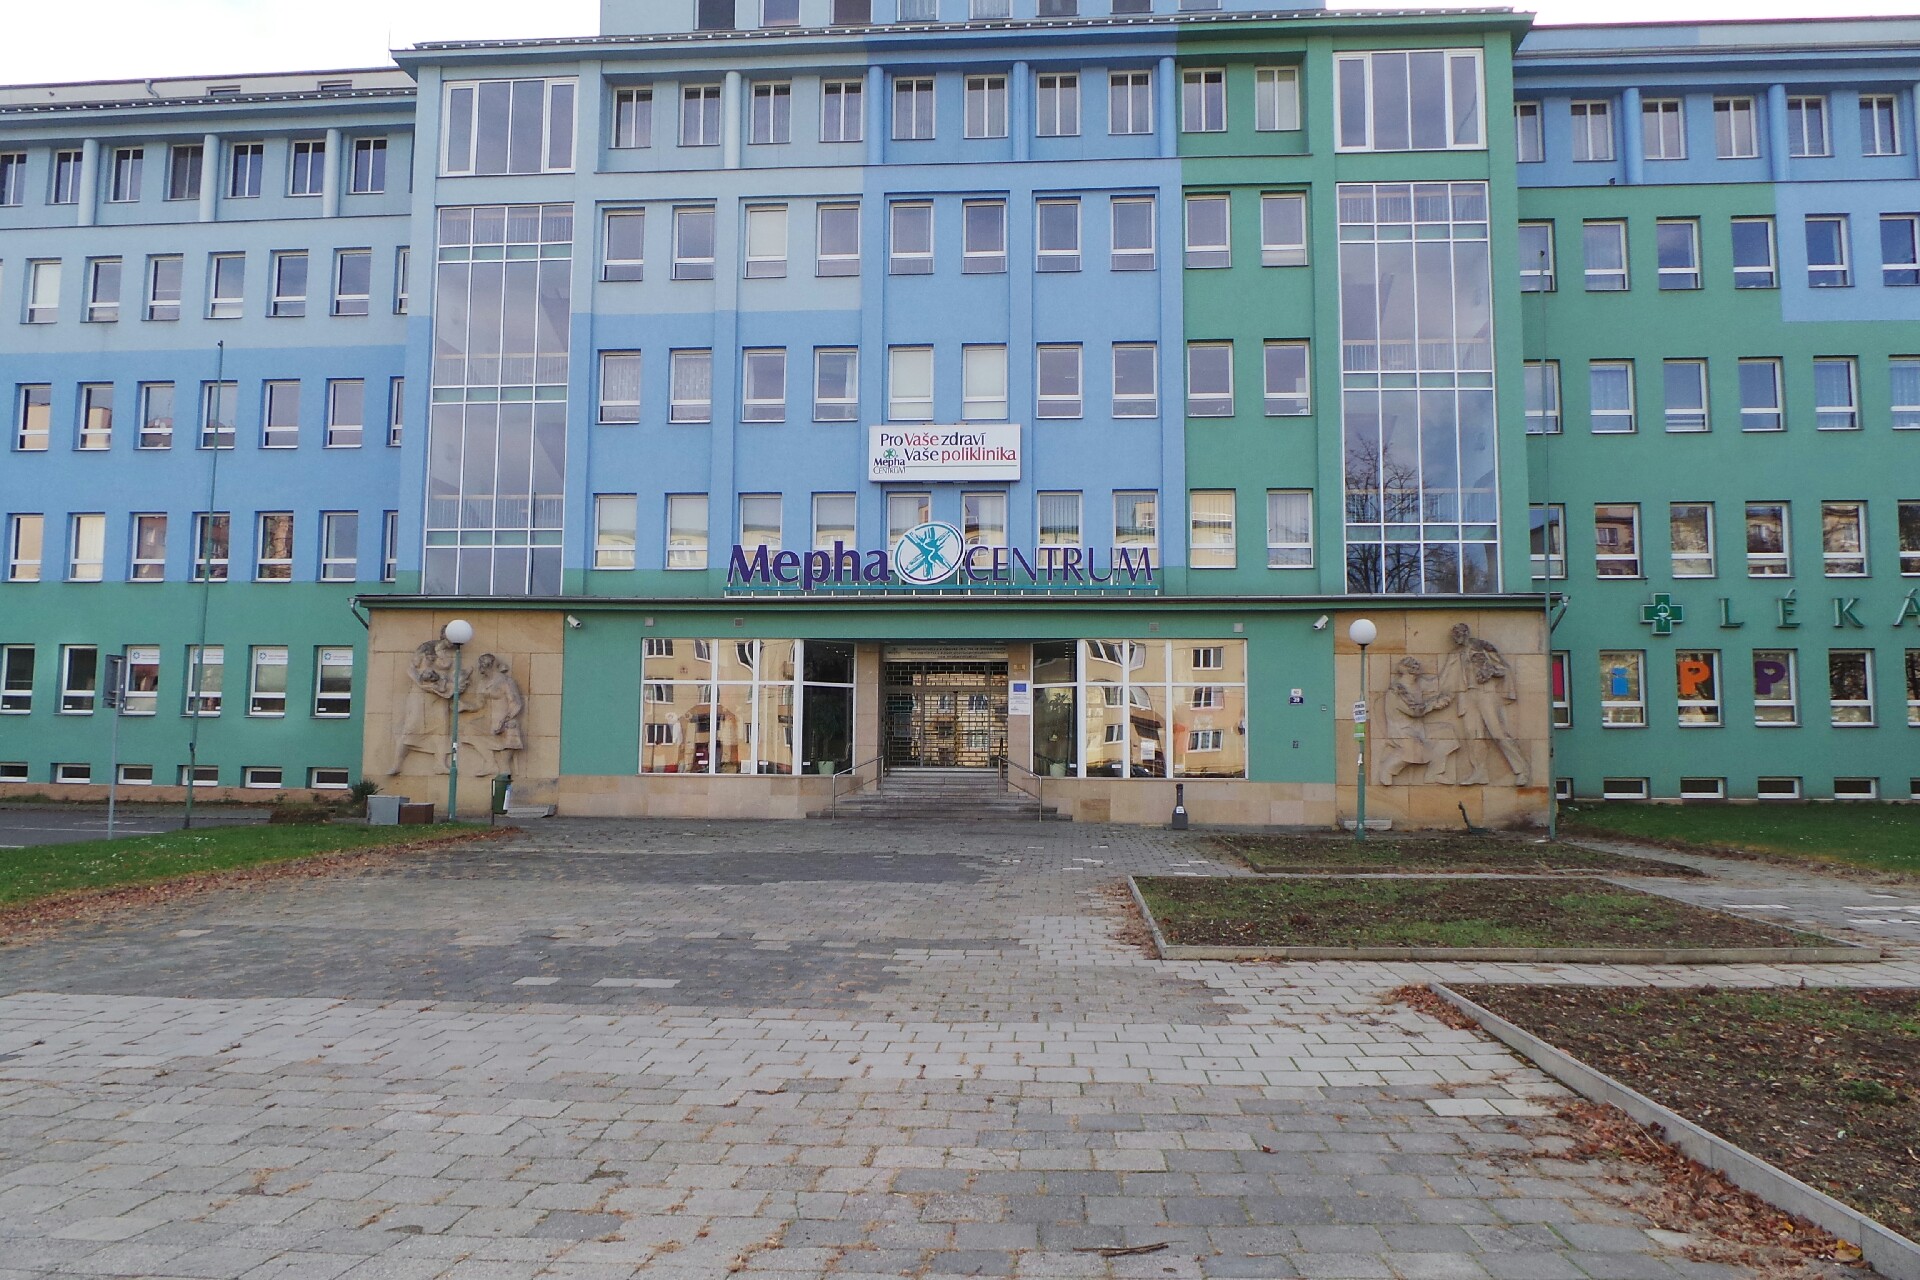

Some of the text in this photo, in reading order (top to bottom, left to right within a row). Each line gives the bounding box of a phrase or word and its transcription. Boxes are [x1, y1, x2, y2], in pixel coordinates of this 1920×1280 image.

[880, 432, 986, 446] Pro Vaše zdraví
[873, 457, 905, 467] Mepha
[904, 446, 1016, 463] Vaše poliklinika
[726, 540, 1154, 590] Mepha CENTRUM
